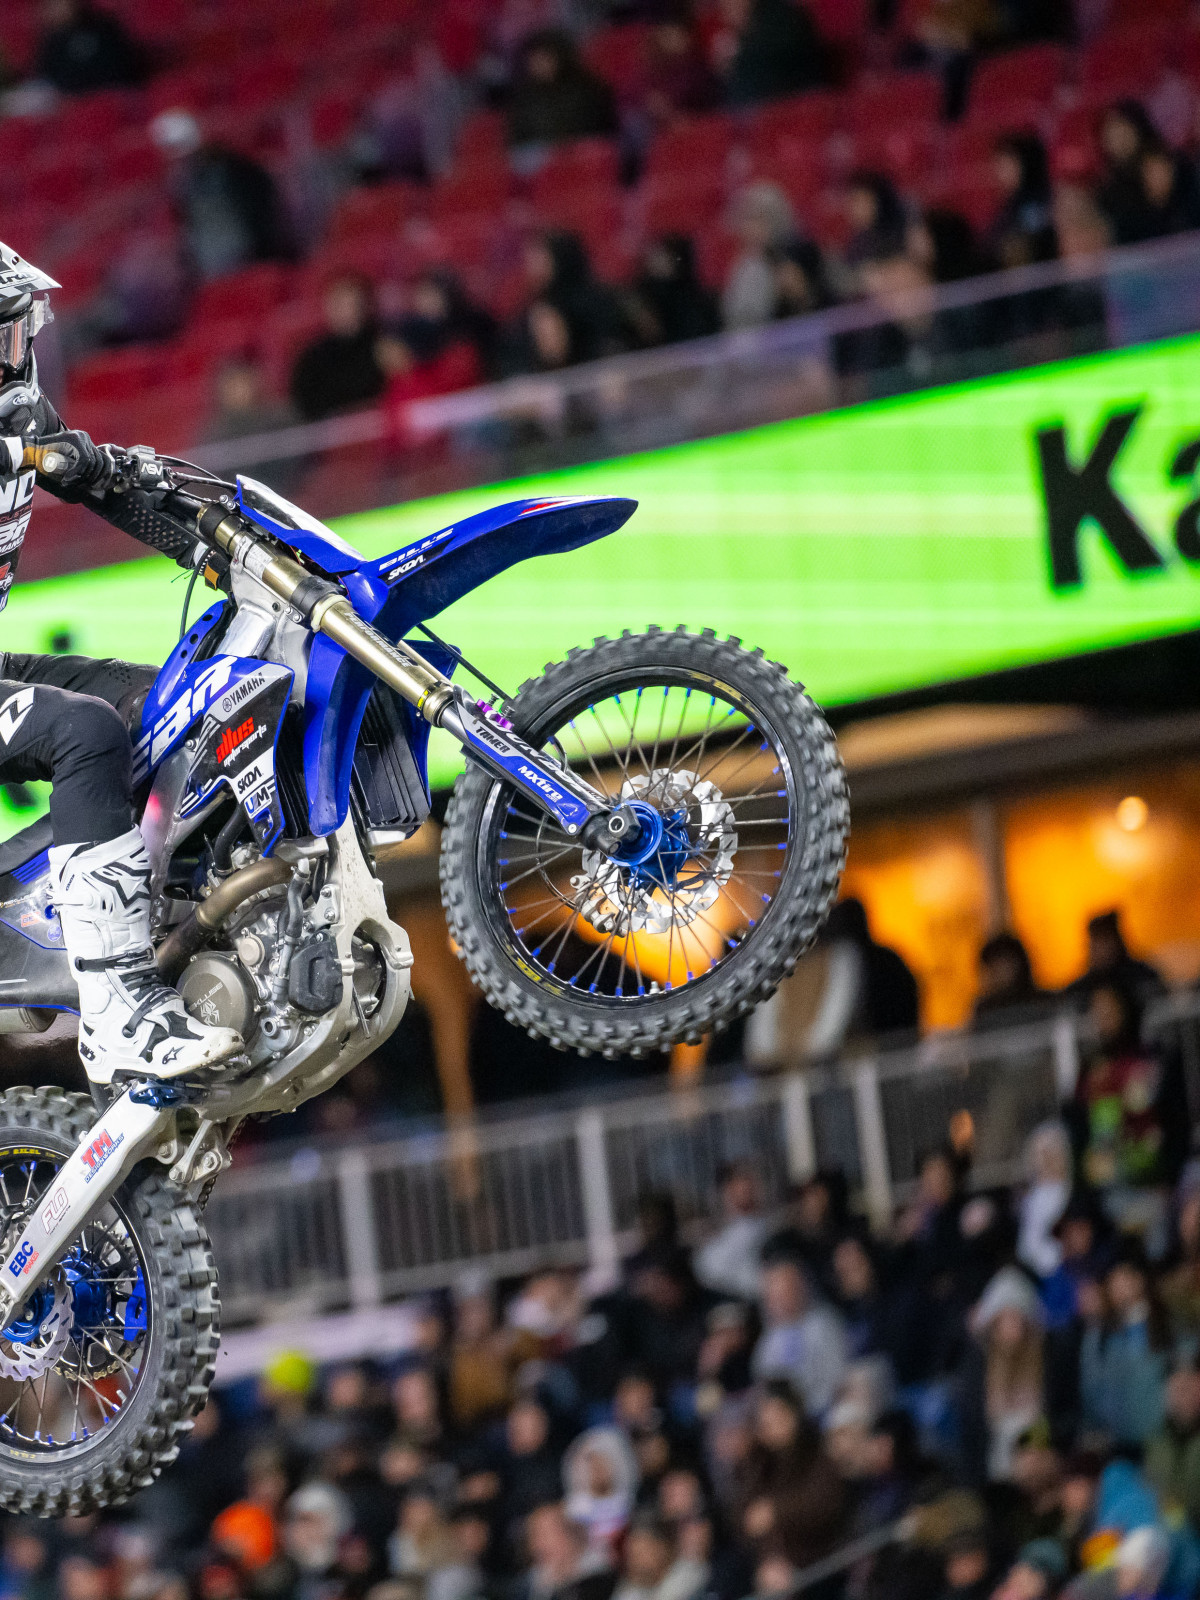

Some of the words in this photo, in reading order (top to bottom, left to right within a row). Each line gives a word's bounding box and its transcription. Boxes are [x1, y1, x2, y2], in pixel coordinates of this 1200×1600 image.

[230, 672, 266, 706] YAMAHA
[475, 726, 511, 754] TAMER
[81, 1129, 113, 1168] TM
[8, 1241, 34, 1277] EBC
[13, 1251, 40, 1275] BRAKES
